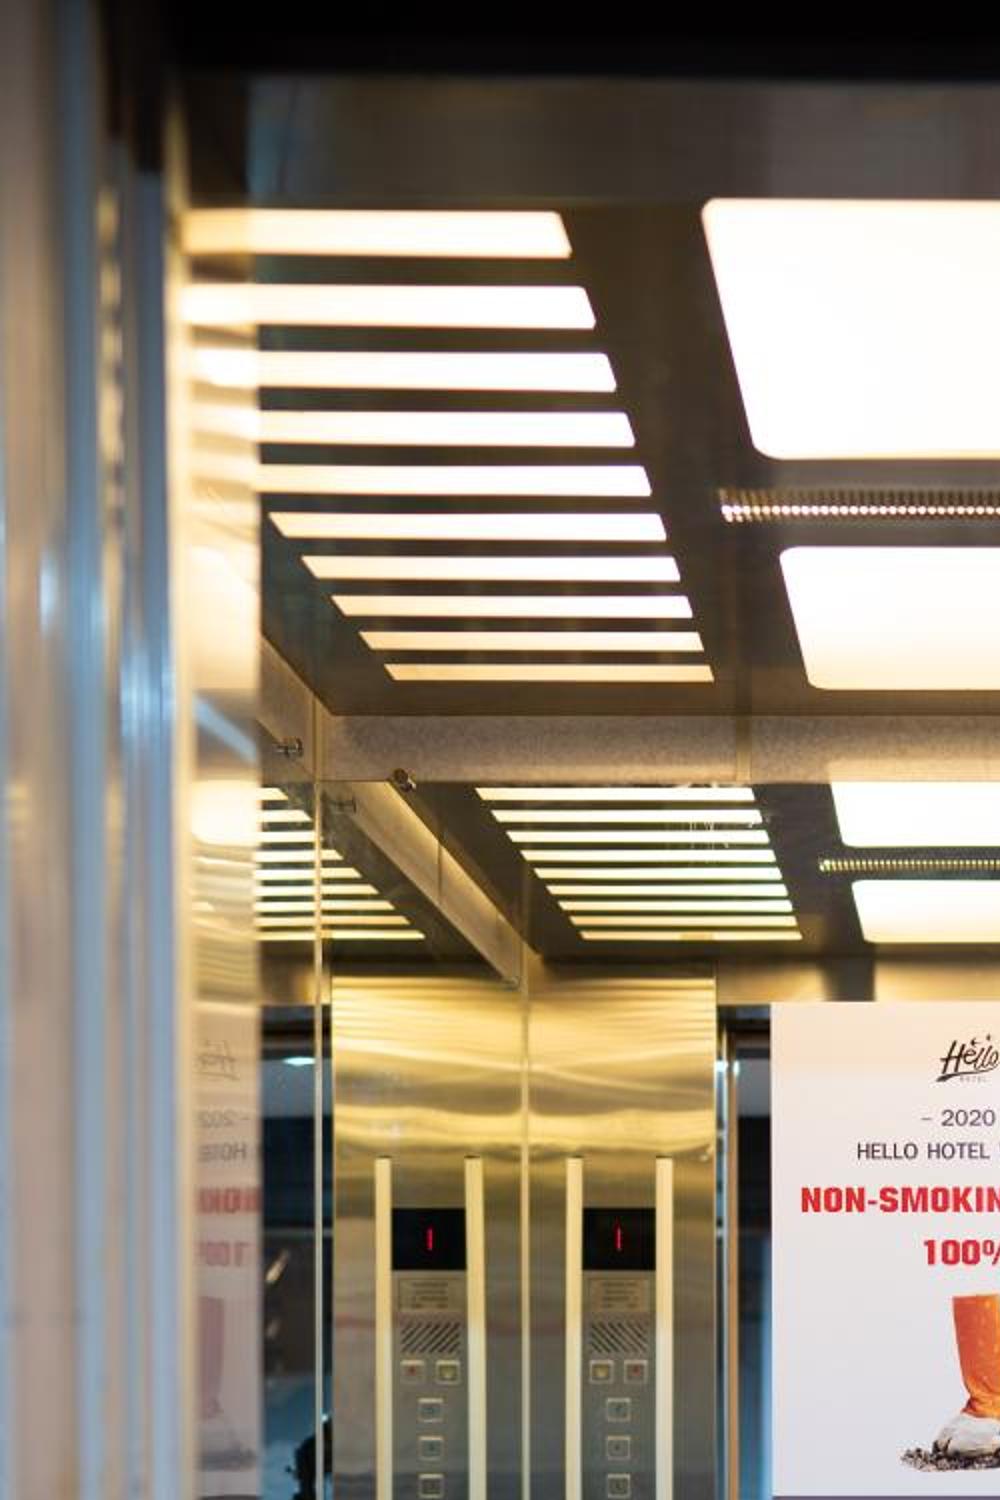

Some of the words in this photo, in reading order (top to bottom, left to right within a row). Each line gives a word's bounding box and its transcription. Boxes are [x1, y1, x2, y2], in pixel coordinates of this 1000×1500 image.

[938, 1037, 1000, 1078] Hello
[941, 1108, 996, 1127] 2020
[856, 1142, 919, 1161] HELLO
[927, 1142, 990, 1160] HOTEL
